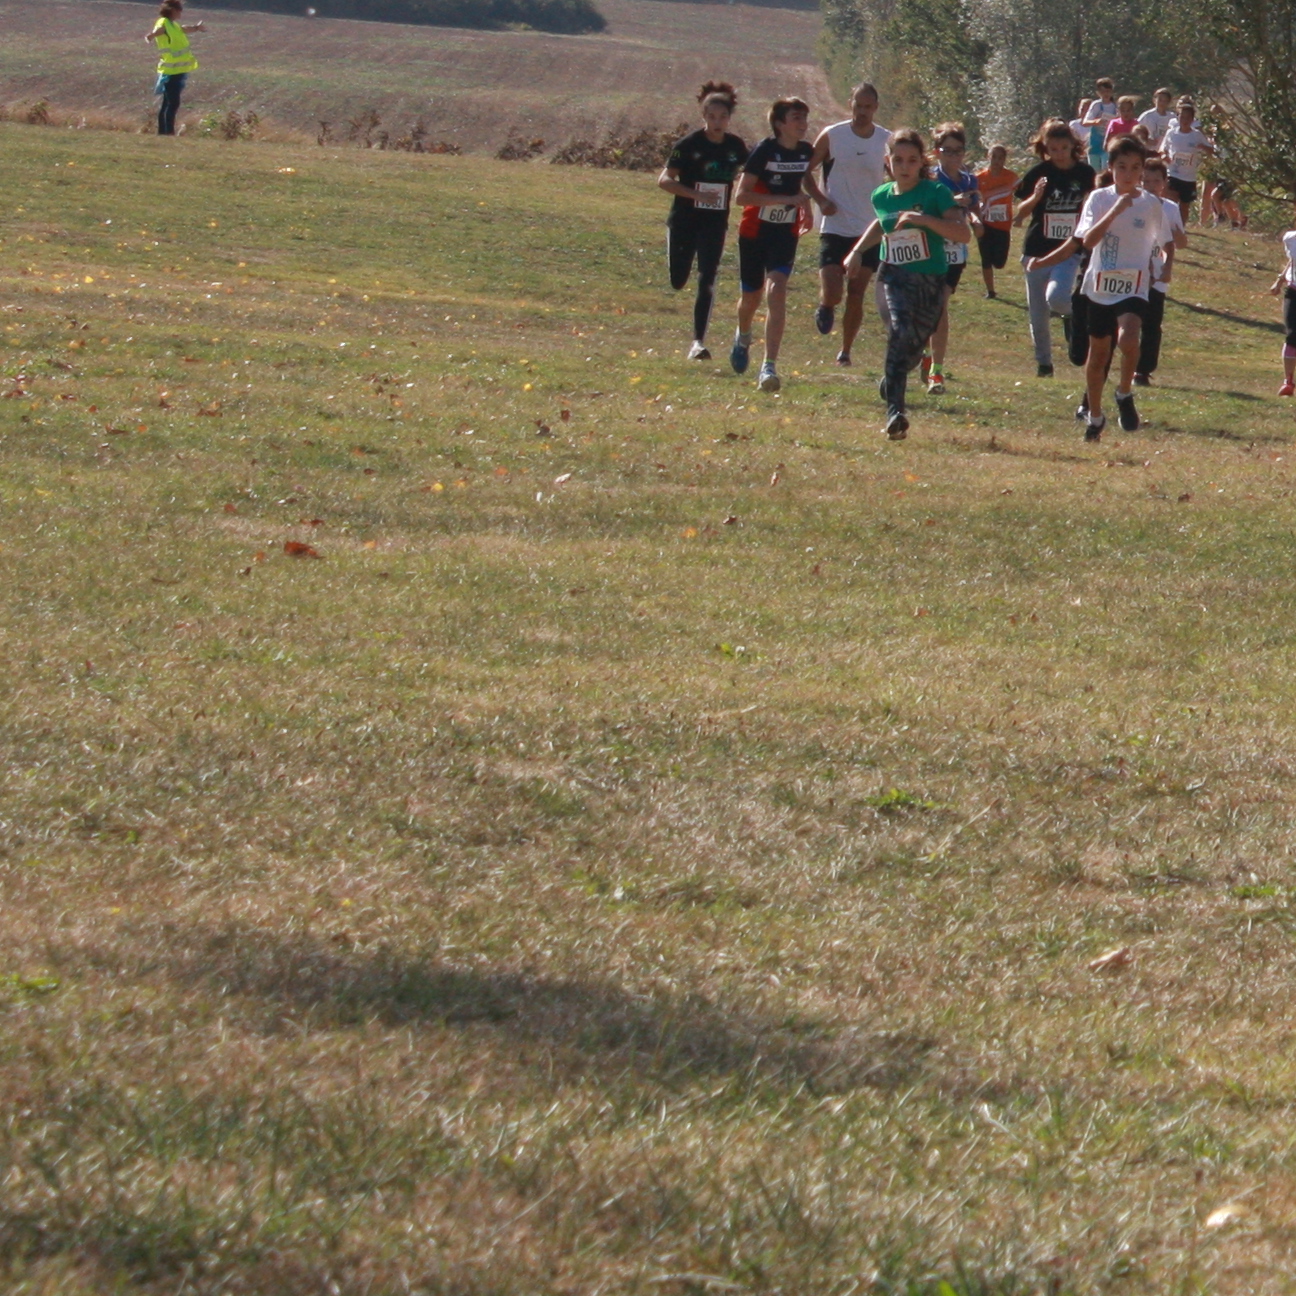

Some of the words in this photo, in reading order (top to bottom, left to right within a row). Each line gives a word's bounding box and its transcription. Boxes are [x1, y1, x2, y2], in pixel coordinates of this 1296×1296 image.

[1051, 225, 1073, 238] 1021
[891, 244, 921, 262] 1008
[1103, 277, 1133, 294] 1028
